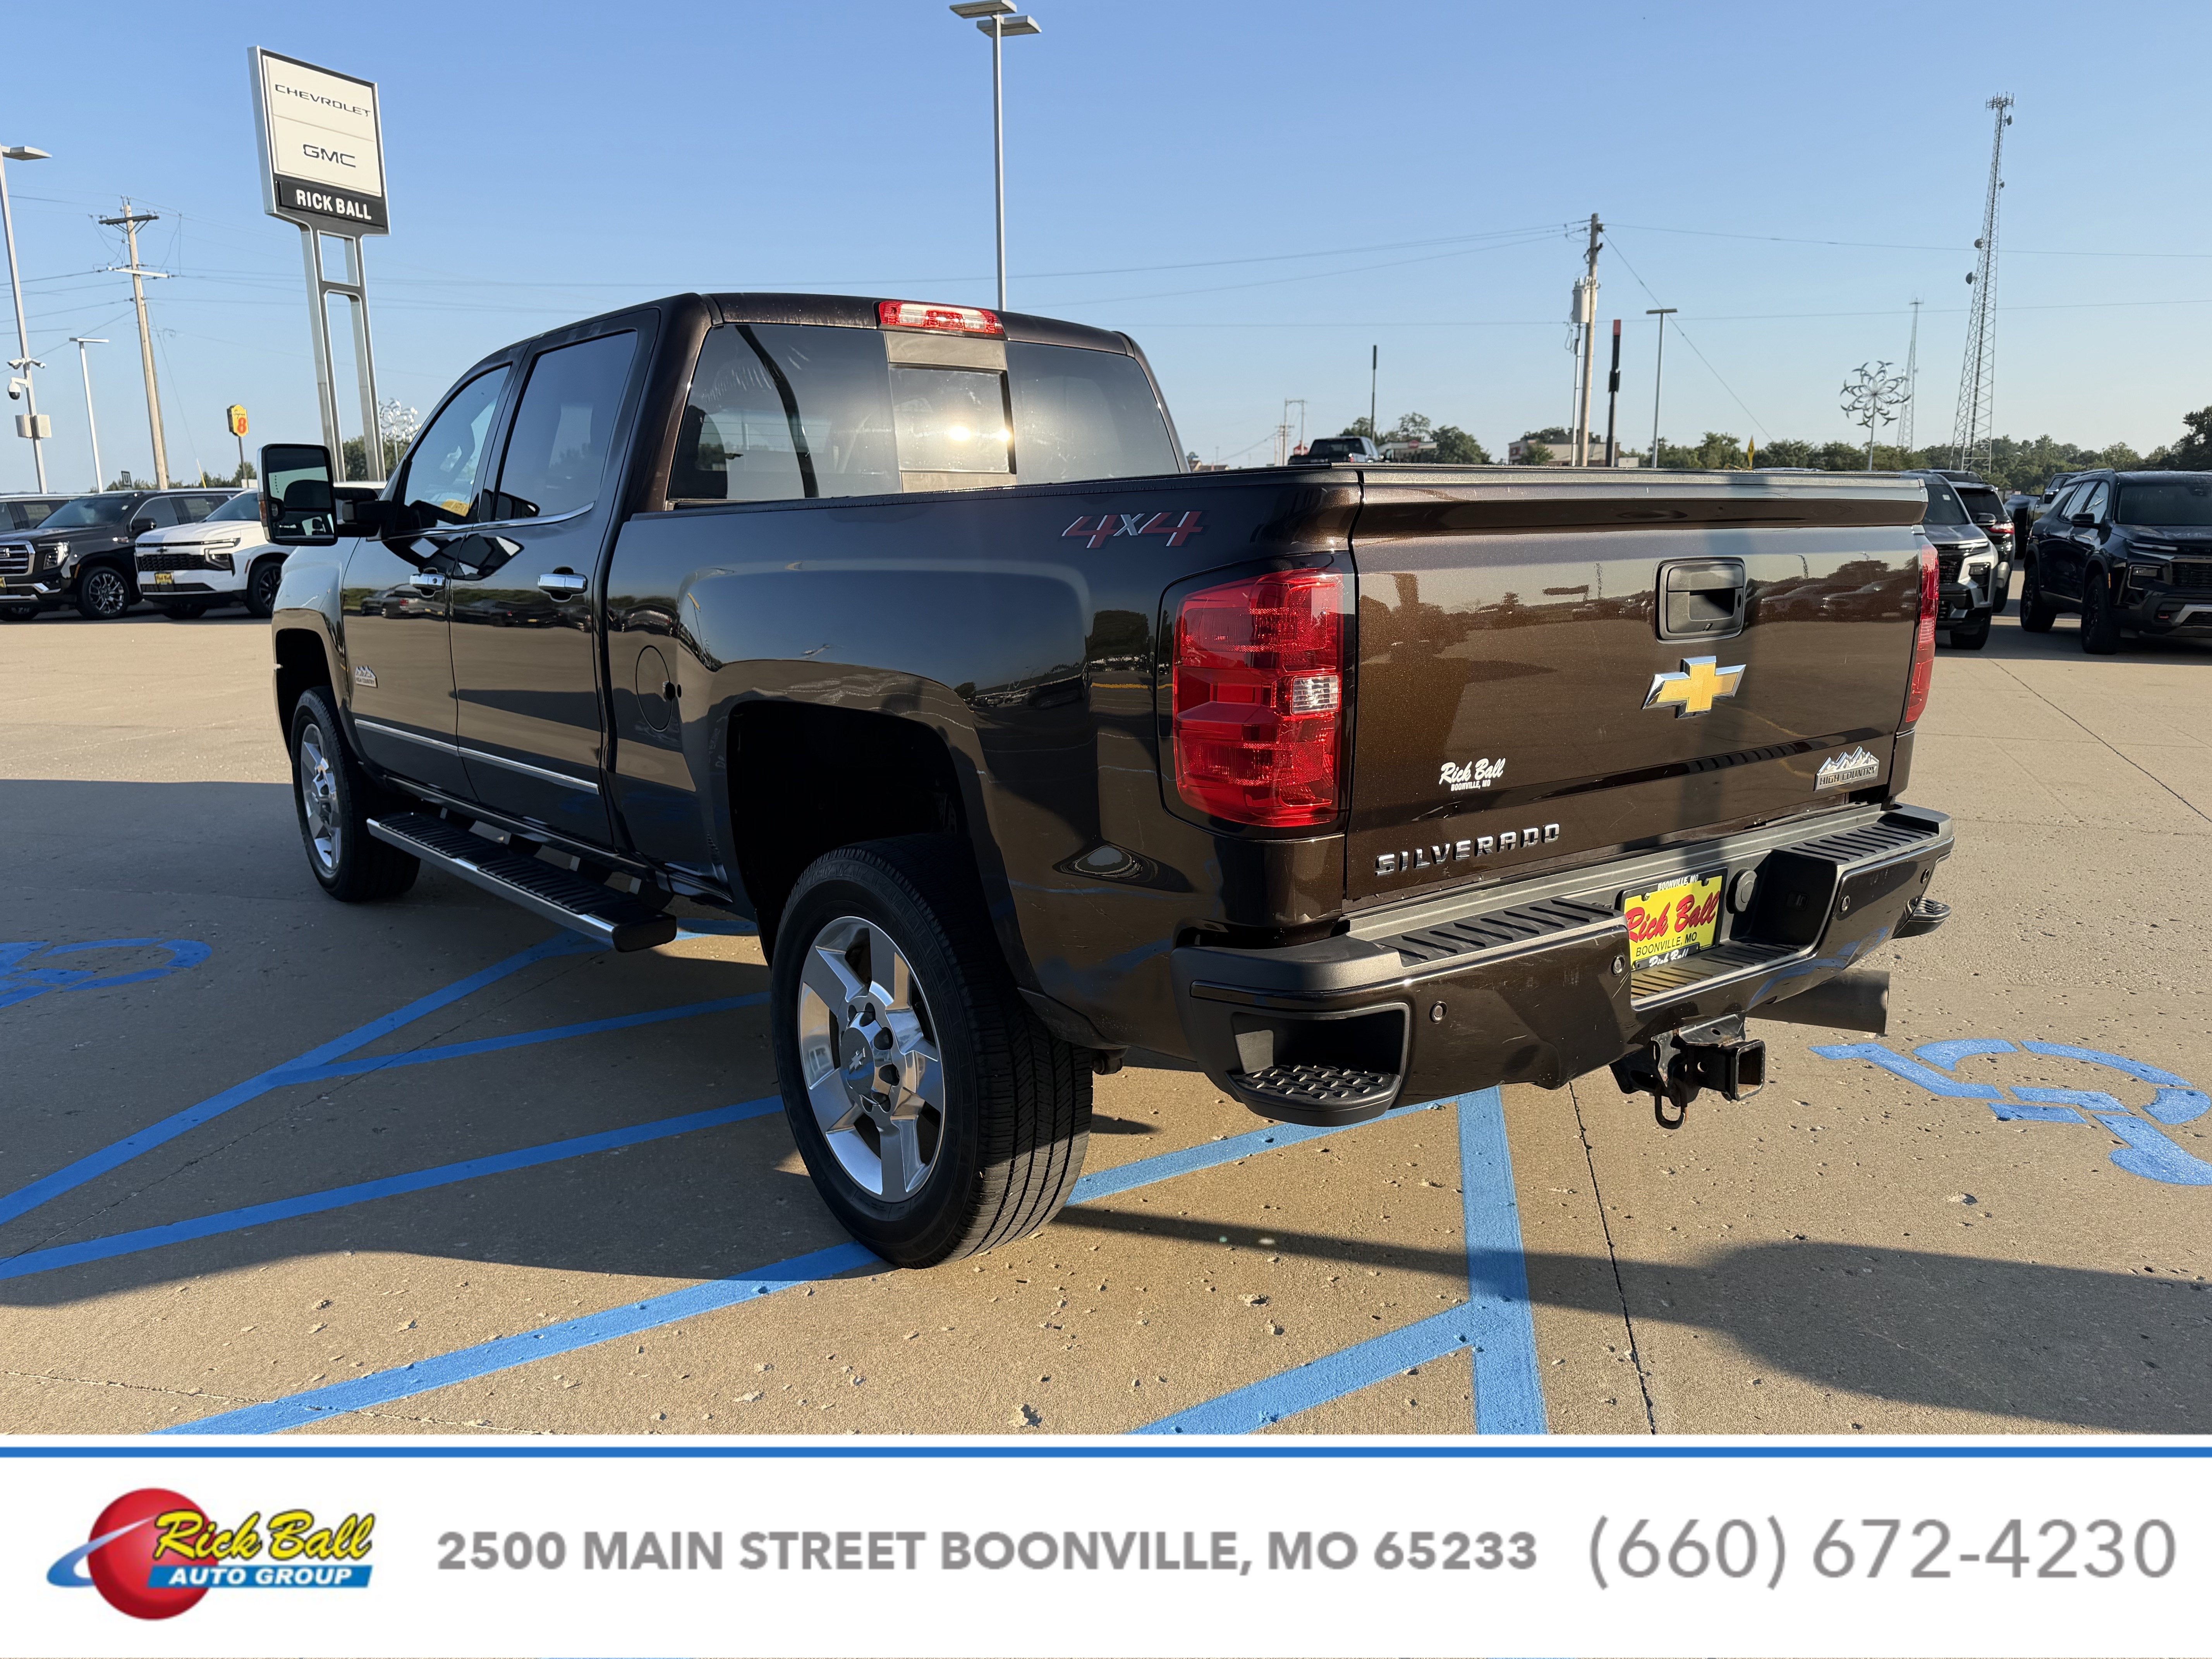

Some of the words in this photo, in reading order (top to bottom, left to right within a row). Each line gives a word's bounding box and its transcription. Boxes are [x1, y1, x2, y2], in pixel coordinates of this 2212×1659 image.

[275, 84, 371, 117] CHEVROLET
[303, 144, 356, 168] GMC
[295, 189, 333, 212] RICK
[336, 200, 372, 220] BALL
[237, 417, 247, 434] 8
[124, 474, 129, 484] U
[1439, 761, 1472, 785] Rick
[1474, 757, 1506, 780] Ball
[1820, 774, 1839, 785] HIGH
[1842, 766, 1877, 781] COUNTRY
[1451, 780, 1481, 792] BOONVILLE,
[1375, 823, 1560, 876] SILVERADO
[1690, 874, 1698, 884] MO
[1625, 902, 1671, 943] Rick
[1674, 890, 1721, 933] Ball
[1635, 936, 1682, 957] BOONVILLE,
[1685, 931, 1697, 943] MO
